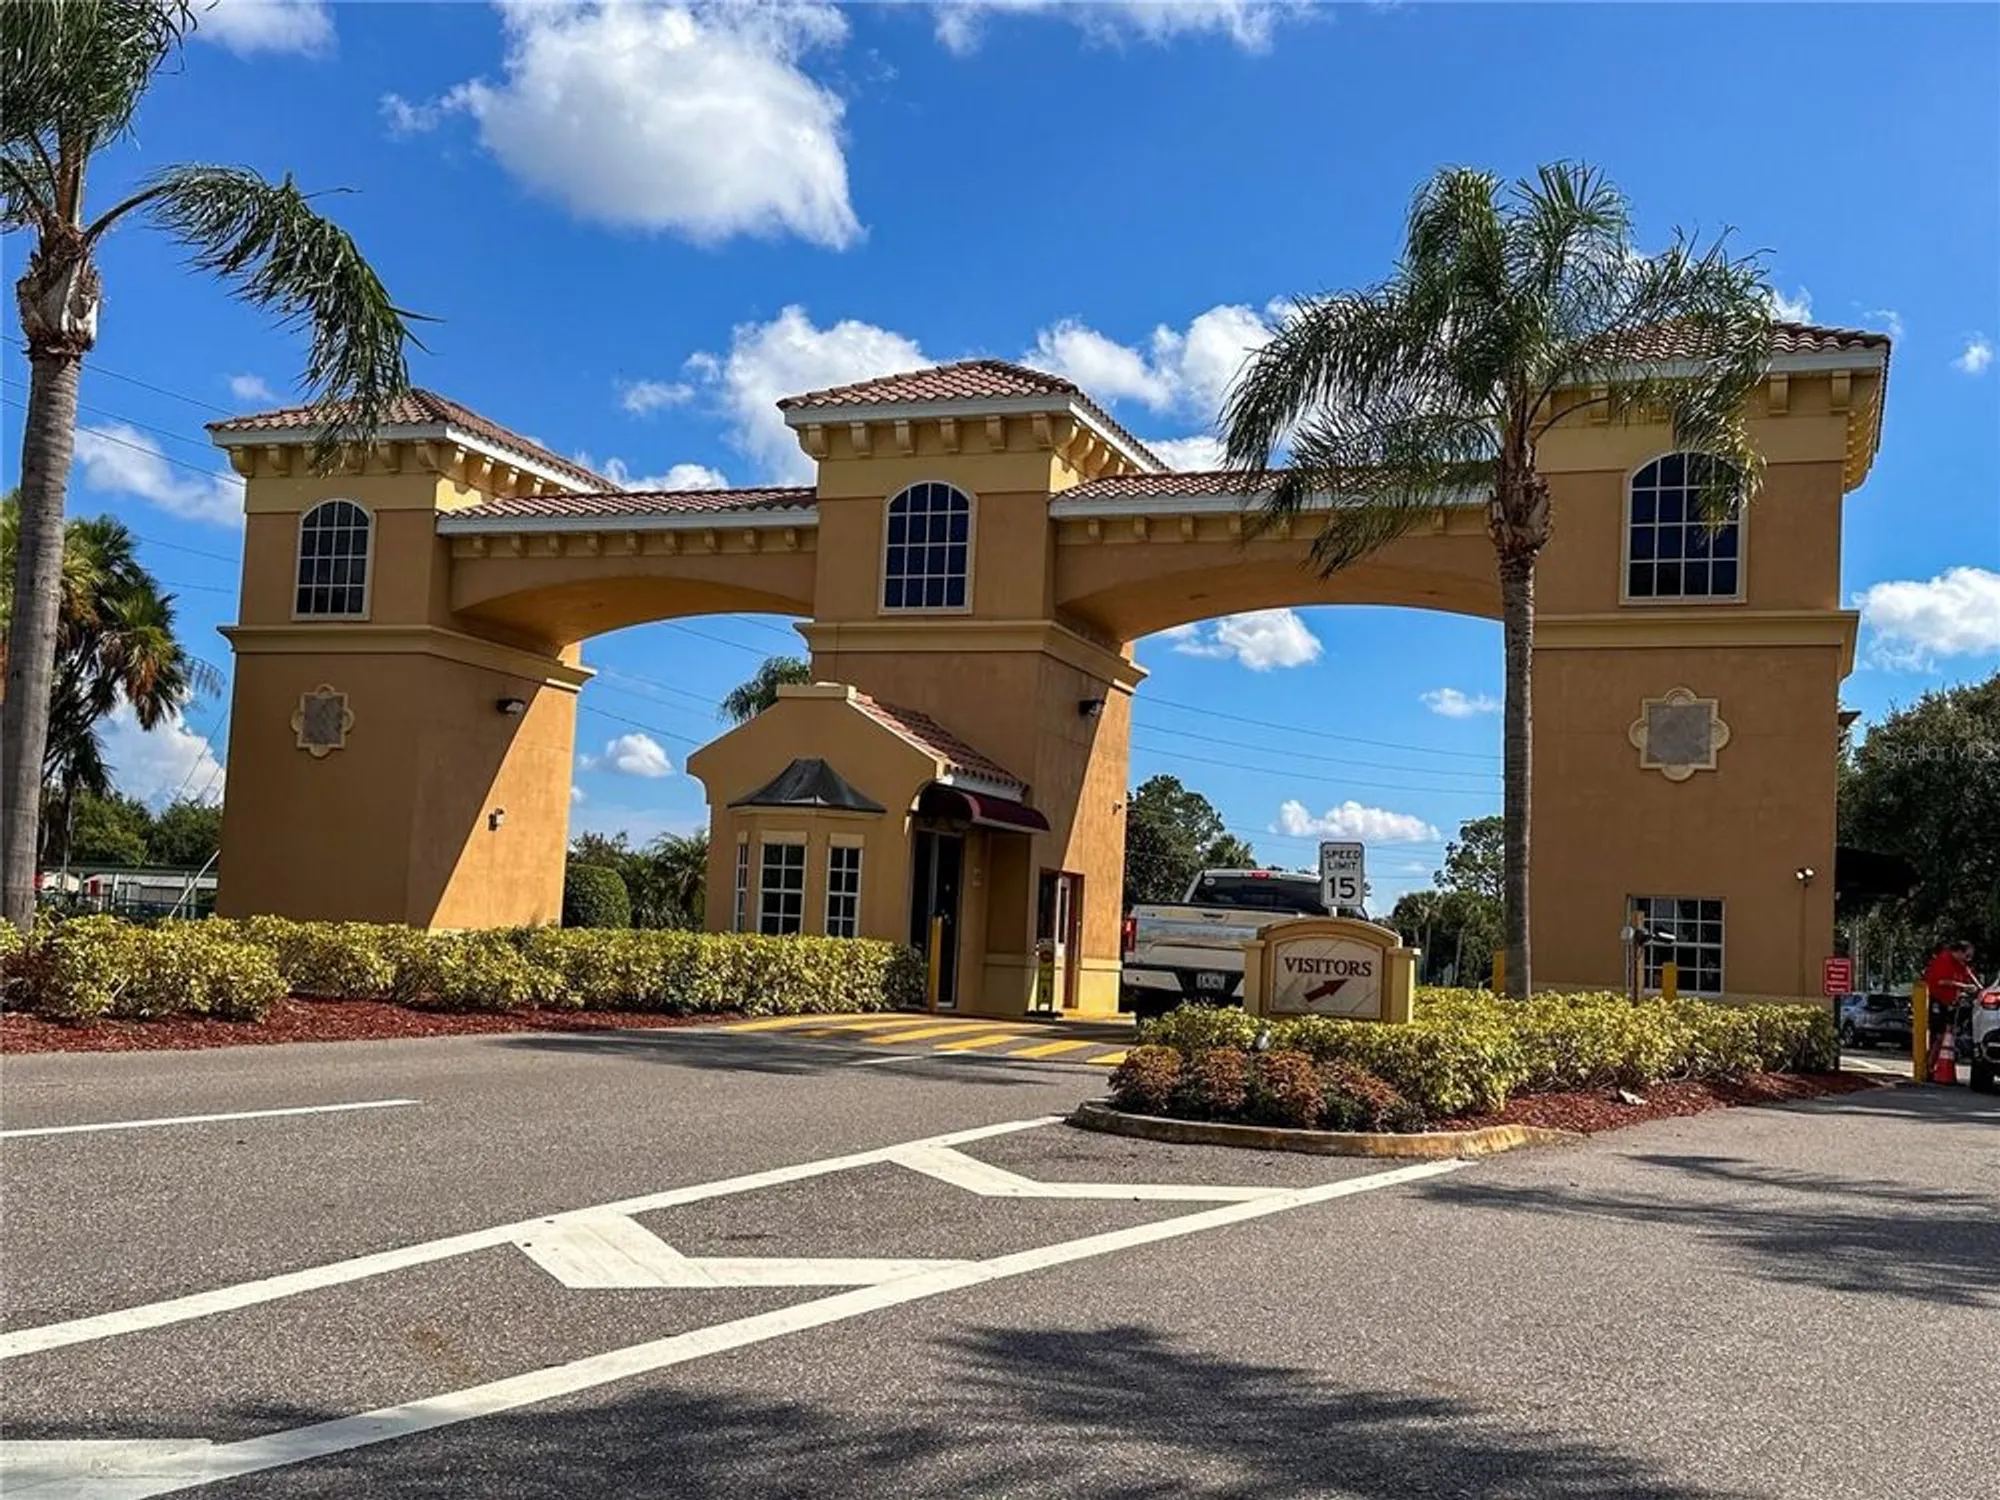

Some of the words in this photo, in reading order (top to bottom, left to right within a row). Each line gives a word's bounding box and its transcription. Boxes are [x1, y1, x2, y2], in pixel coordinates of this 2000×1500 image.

[1325, 849, 1361, 860] SPEED
[1328, 860, 1357, 871] LIMIT
[1328, 876, 1356, 899] 15
[1284, 956, 1372, 977] VISITORS
